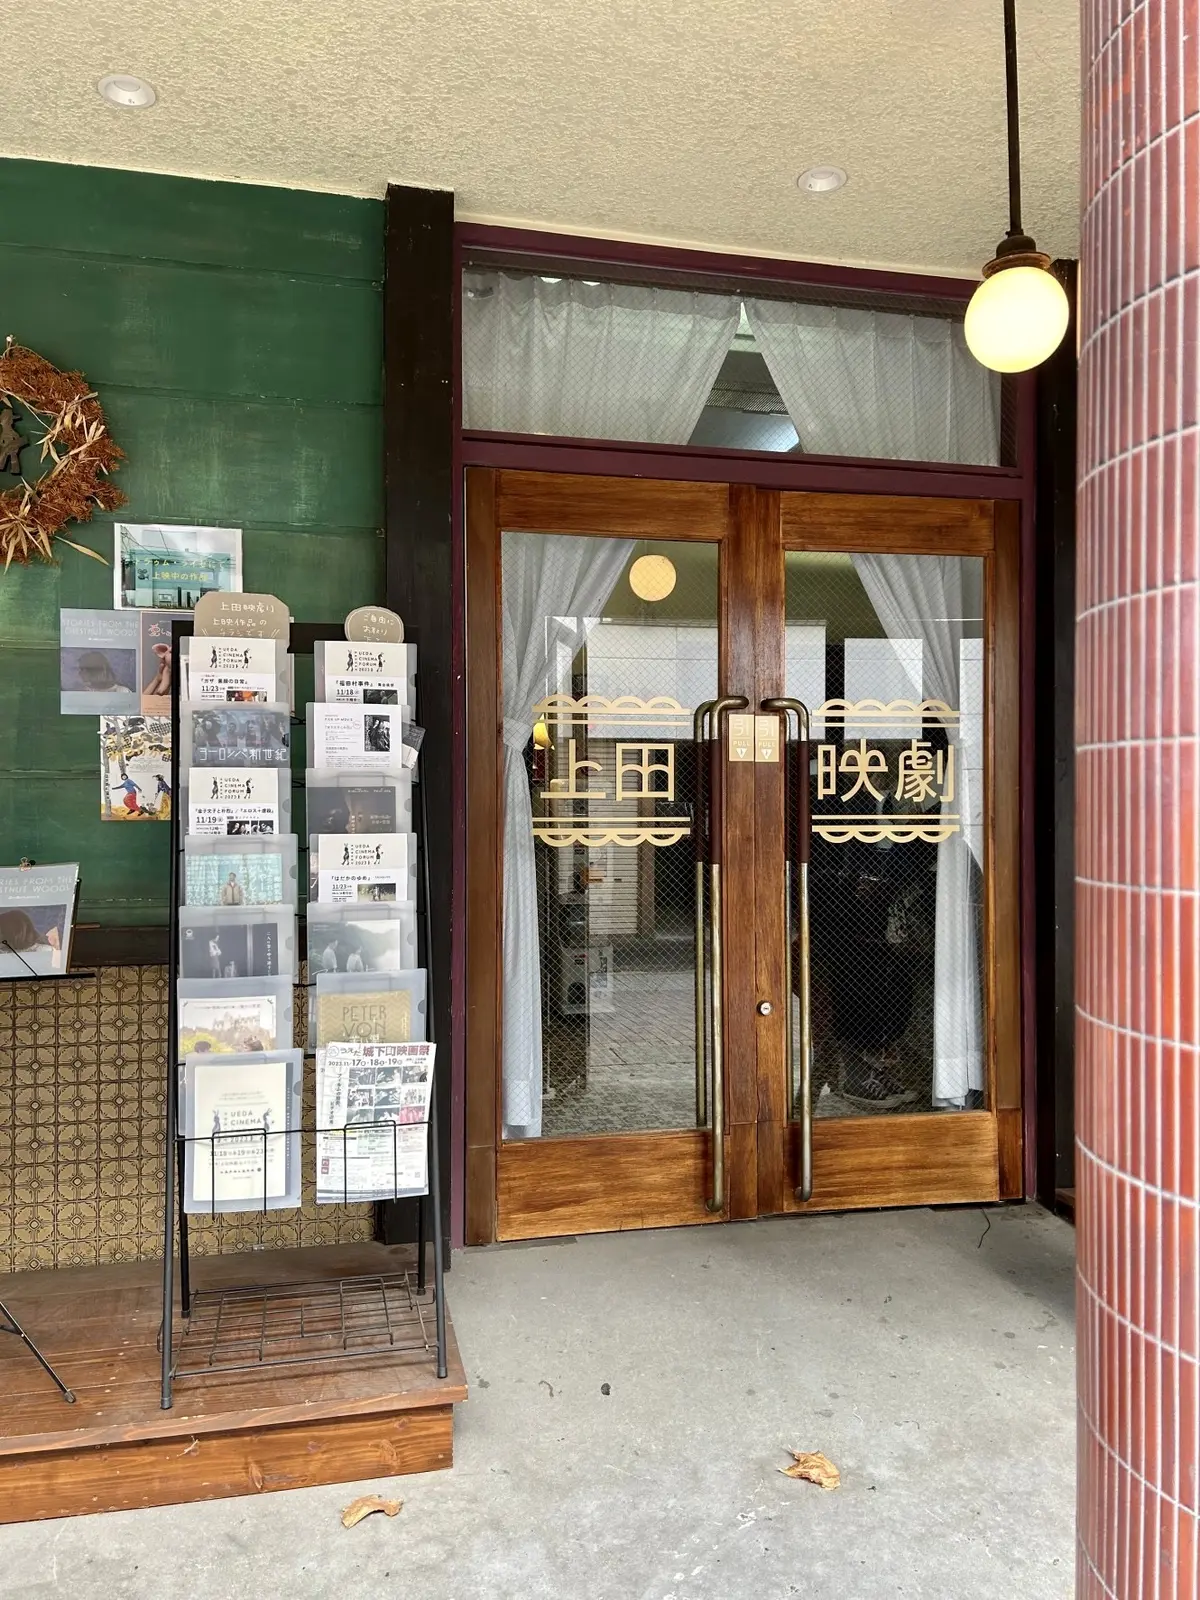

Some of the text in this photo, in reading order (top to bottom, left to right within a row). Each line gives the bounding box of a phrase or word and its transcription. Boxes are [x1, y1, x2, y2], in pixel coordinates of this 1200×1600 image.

[733, 718, 750, 736] 引
[760, 719, 774, 737] 引
[540, 738, 955, 803] 上田 映劇
[342, 1004, 388, 1022] PETER
[342, 1021, 388, 1037] VON
